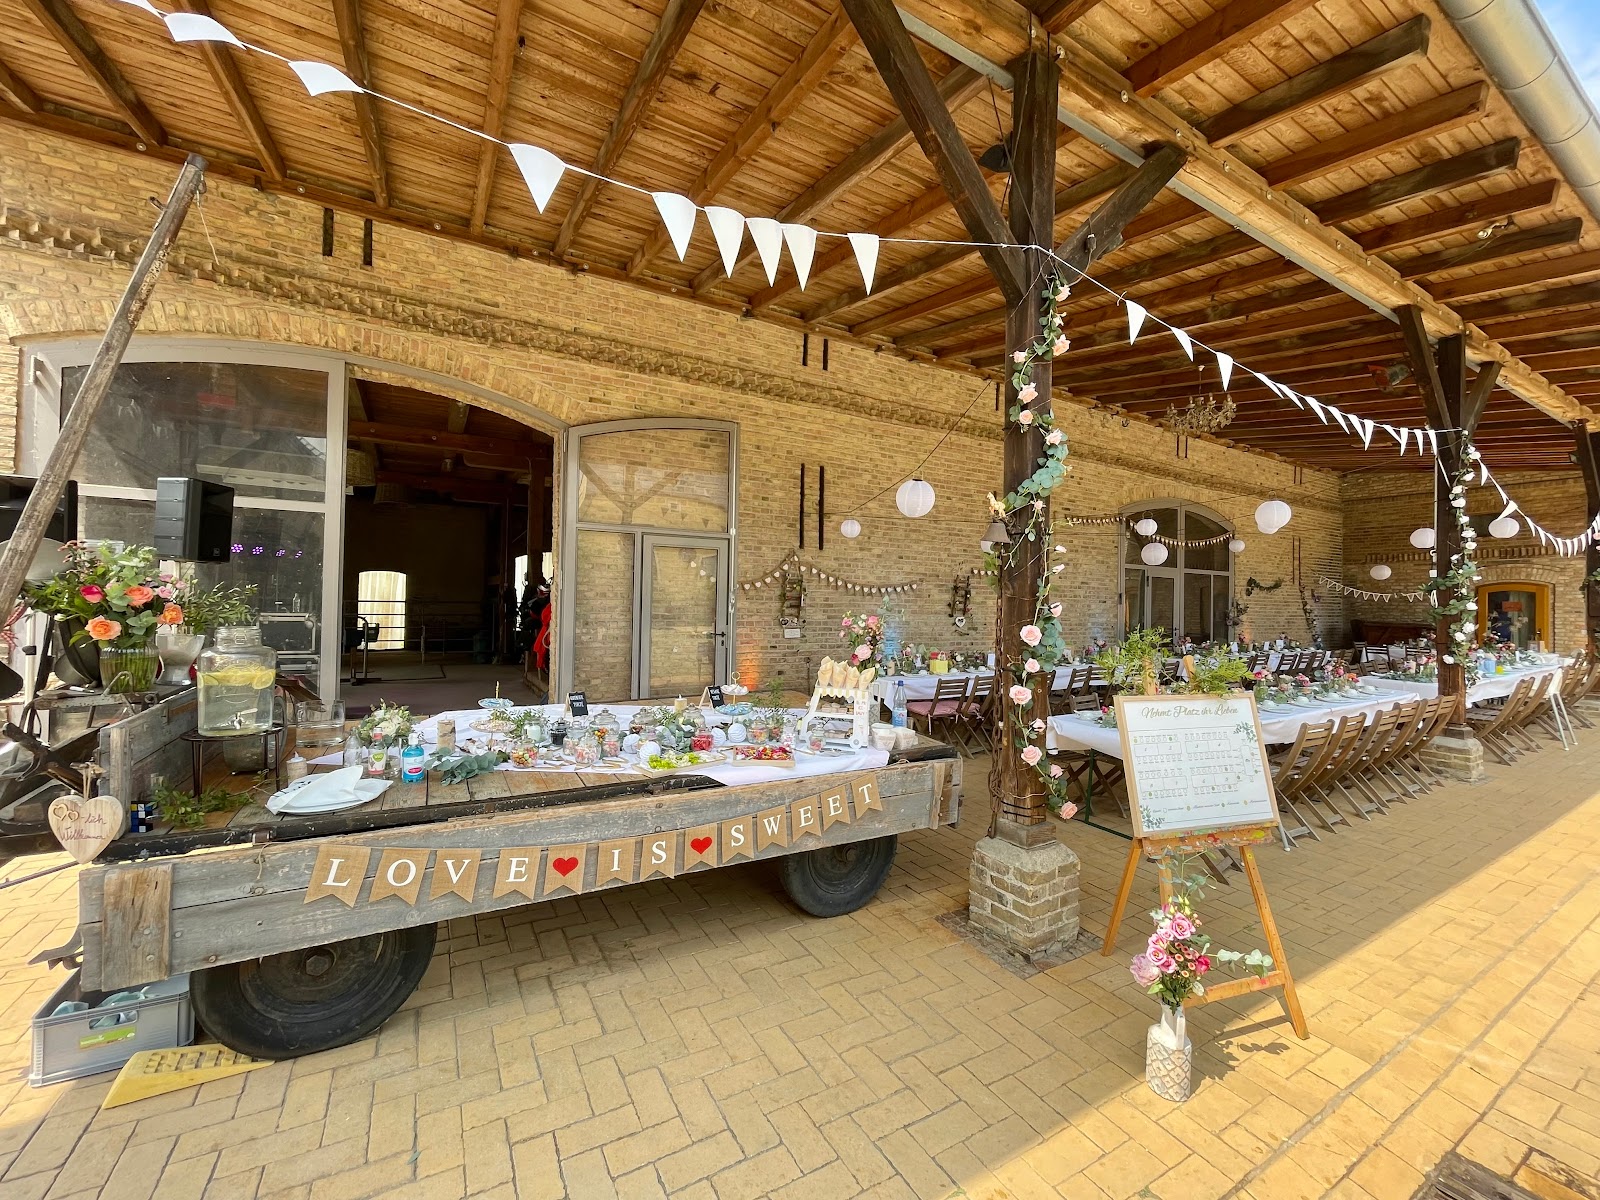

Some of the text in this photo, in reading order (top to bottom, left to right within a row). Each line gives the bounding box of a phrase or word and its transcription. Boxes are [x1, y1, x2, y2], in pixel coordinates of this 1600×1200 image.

[1173, 705, 1200, 718] Platz
[1214, 703, 1238, 716] Lieben
[321, 783, 874, 887] LOVE IS SWEET
